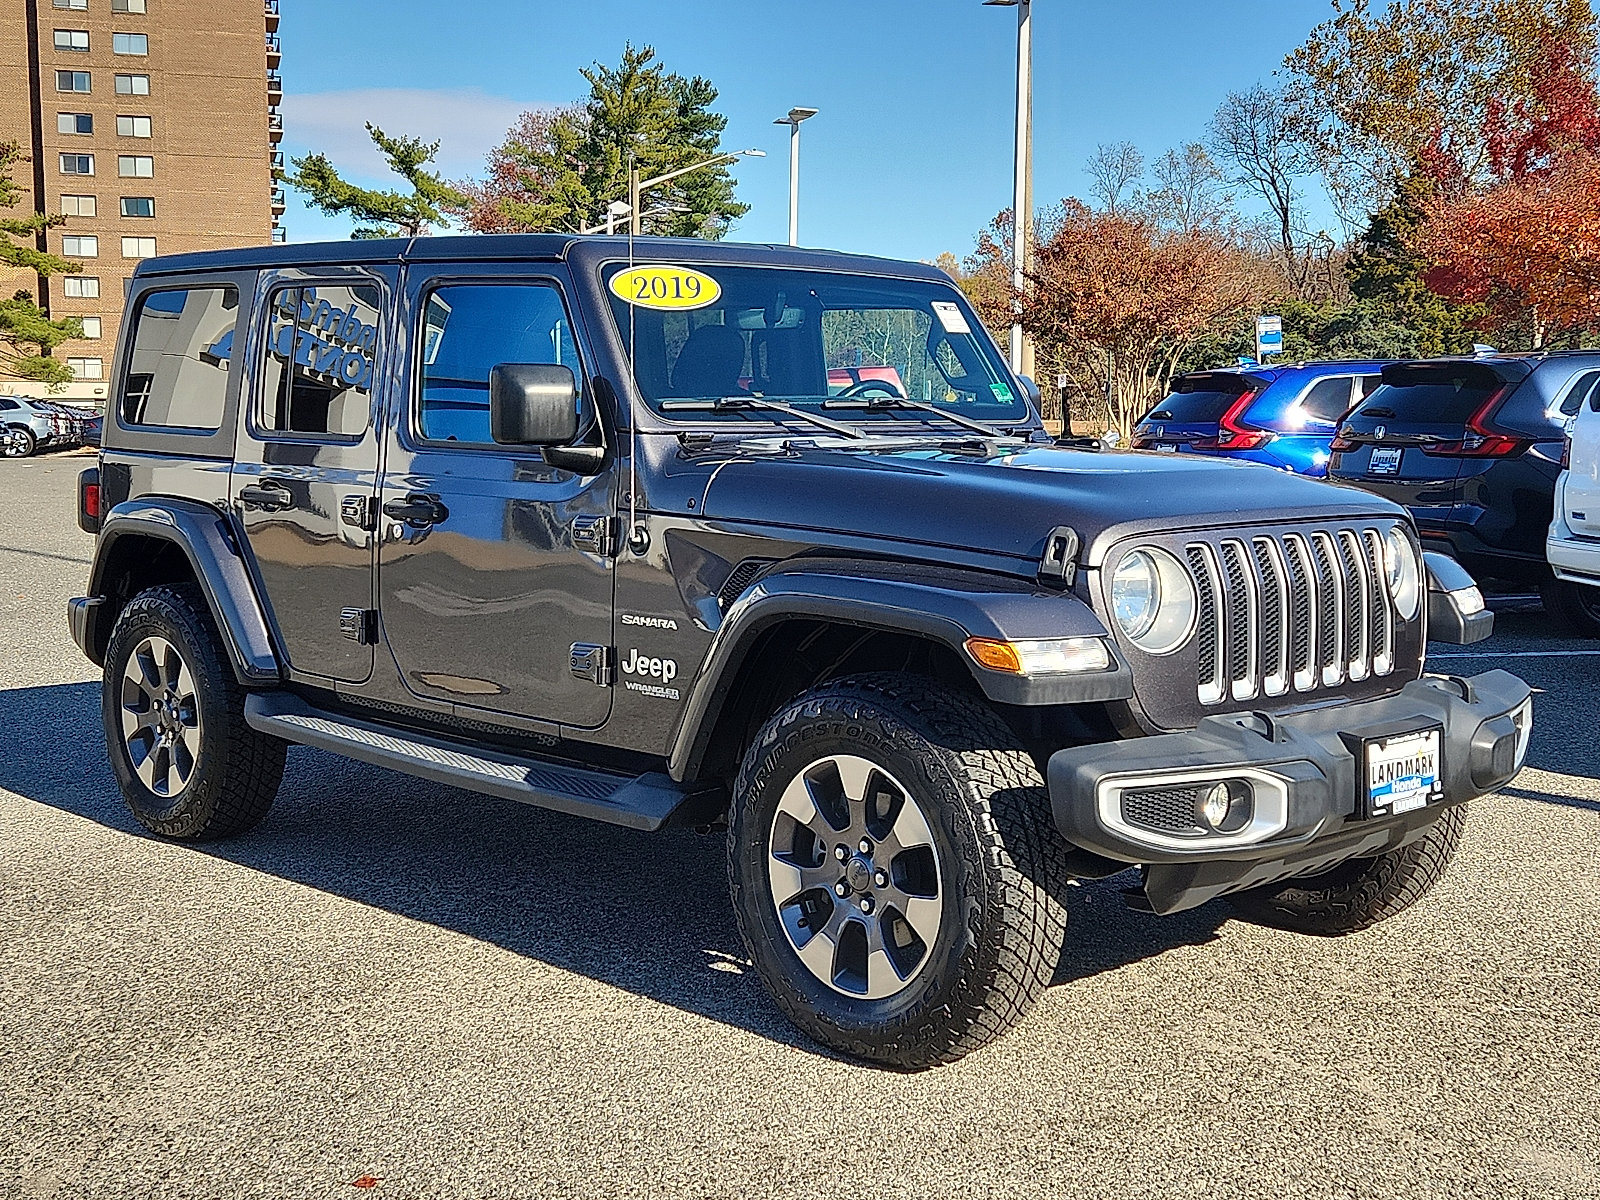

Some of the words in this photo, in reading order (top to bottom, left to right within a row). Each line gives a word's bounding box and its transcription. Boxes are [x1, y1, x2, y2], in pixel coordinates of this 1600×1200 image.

[633, 276, 702, 299] 2019
[621, 614, 679, 631] SAHARA
[621, 648, 677, 684] Jeep
[624, 680, 680, 696] WRANGLER
[1371, 753, 1435, 785] LANDMARK
[1393, 776, 1423, 794] Honda
